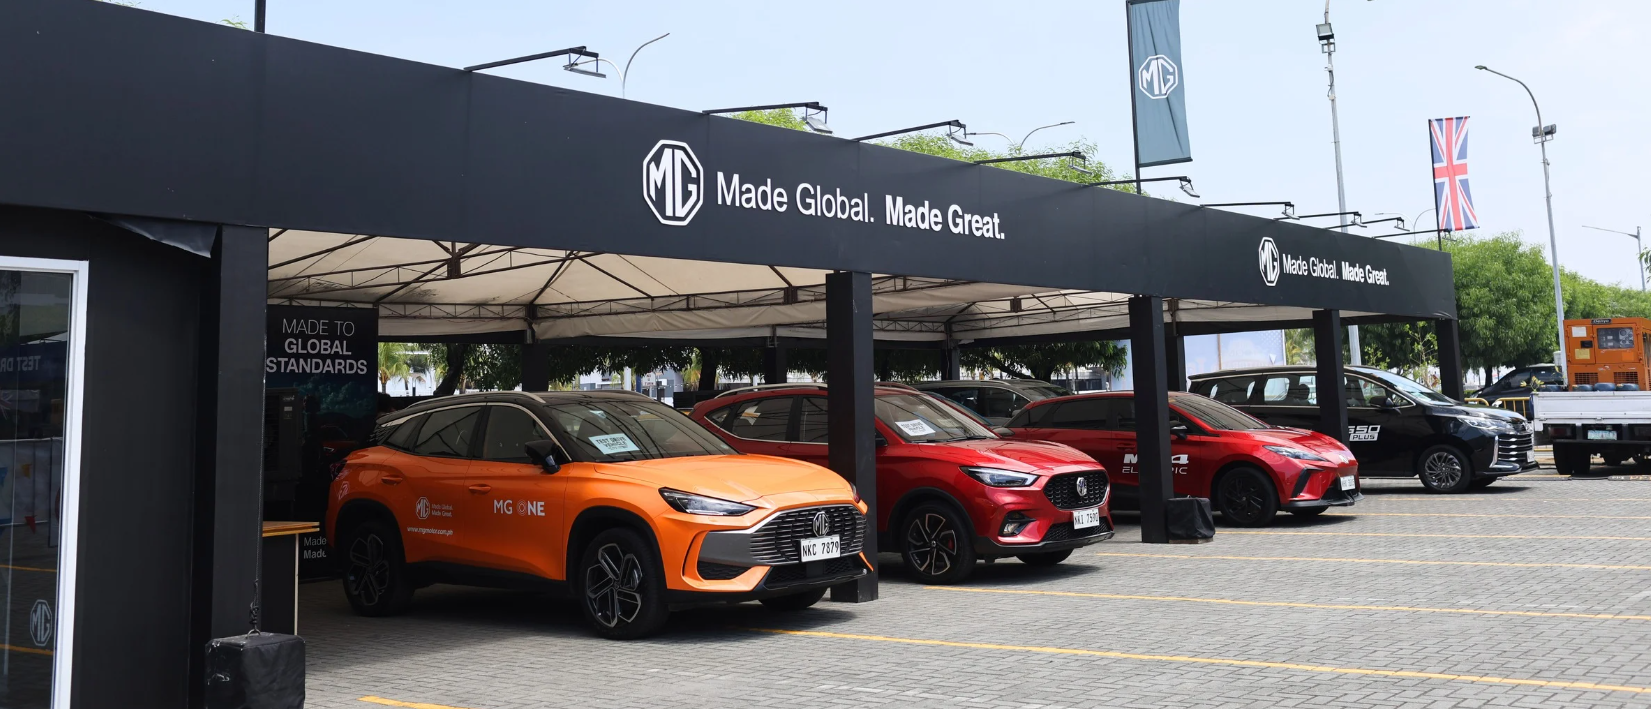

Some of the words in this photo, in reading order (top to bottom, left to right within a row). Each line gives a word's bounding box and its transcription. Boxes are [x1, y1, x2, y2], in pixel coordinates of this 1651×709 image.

[1141, 58, 1174, 95] MG
[648, 147, 698, 218] MG
[716, 171, 788, 213] Made
[795, 182, 875, 224] Global.
[885, 194, 943, 232] Made
[947, 204, 1005, 239] Great.
[1260, 241, 1278, 282] MG
[1282, 253, 1308, 275] Made
[1310, 257, 1339, 279] Global.
[1341, 261, 1364, 283] Made
[1365, 264, 1390, 286] Great.
[282, 318, 329, 335] MADE
[334, 320, 355, 336] TO
[284, 337, 352, 355] GLOBAL
[266, 357, 368, 375] STANDARDS
[1123, 453, 1189, 465] M4
[416, 498, 430, 518] MG
[493, 499, 513, 515] MG
[815, 513, 829, 535] MG
[303, 536, 327, 547] Made
[802, 543, 817, 557] NKC
[821, 541, 840, 554] 7879
[32, 603, 51, 642] MG
